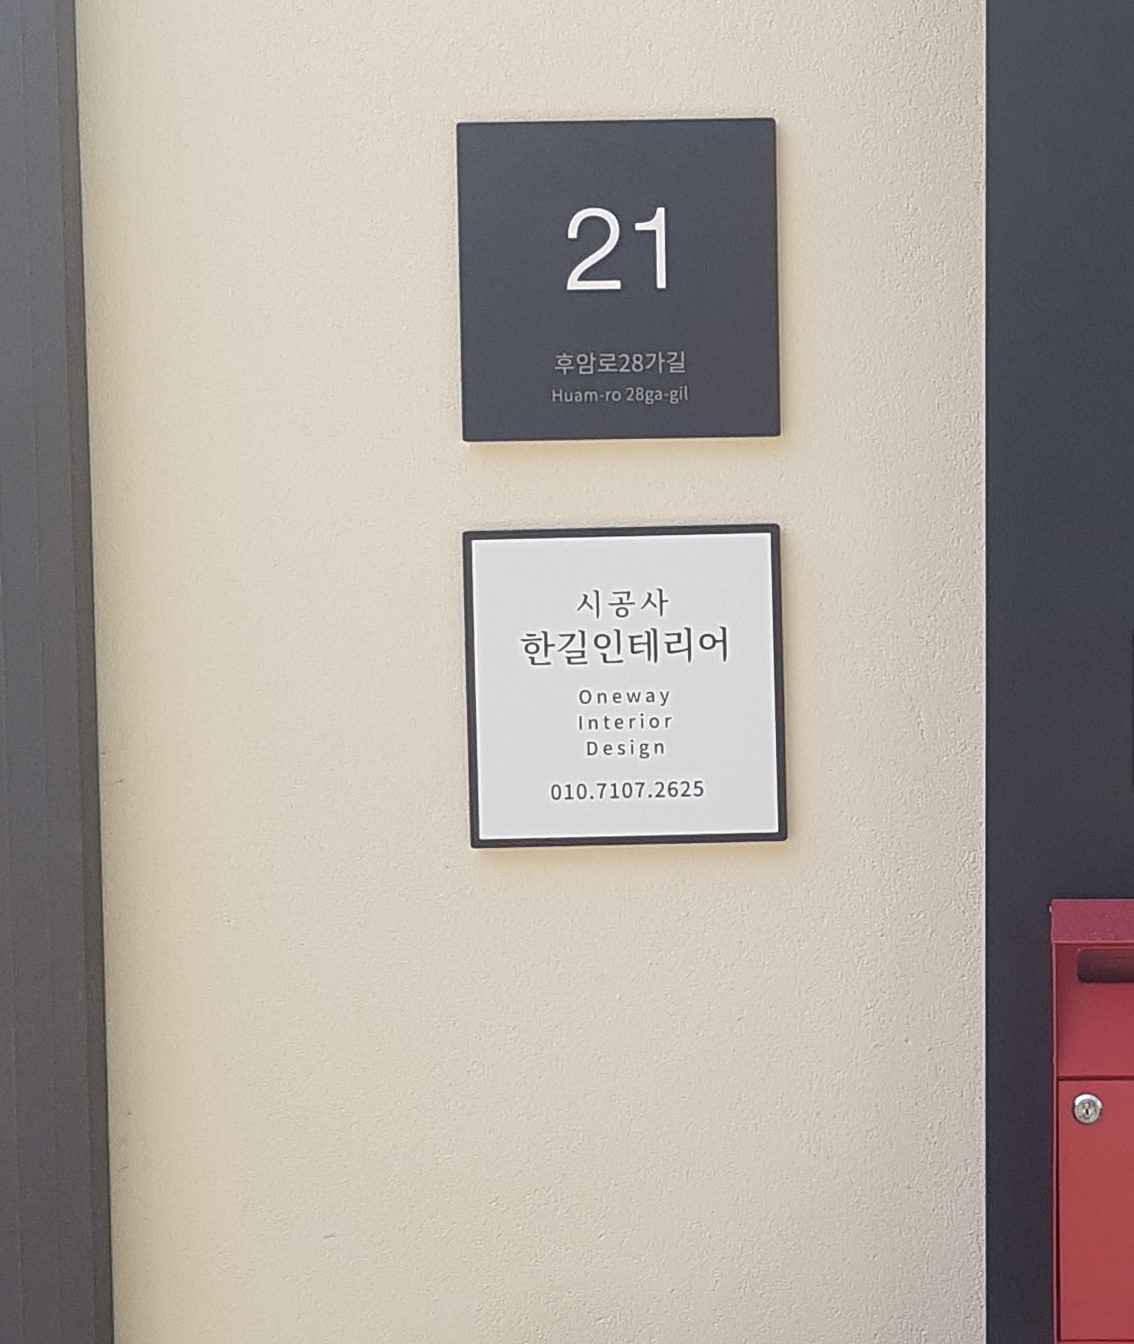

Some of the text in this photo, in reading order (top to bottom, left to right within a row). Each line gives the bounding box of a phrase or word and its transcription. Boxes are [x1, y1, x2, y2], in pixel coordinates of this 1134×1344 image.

[567, 206, 667, 291] 21
[554, 351, 686, 375] 후암로28가길
[551, 385, 689, 405] Huam-ro 28ga-gil
[576, 588, 669, 619] 시공사
[520, 626, 730, 666] 한길인테리어
[578, 688, 671, 706] Oneway
[578, 713, 673, 731] Interior
[586, 739, 666, 759] Design
[550, 780, 705, 801] 010.7107.2625
